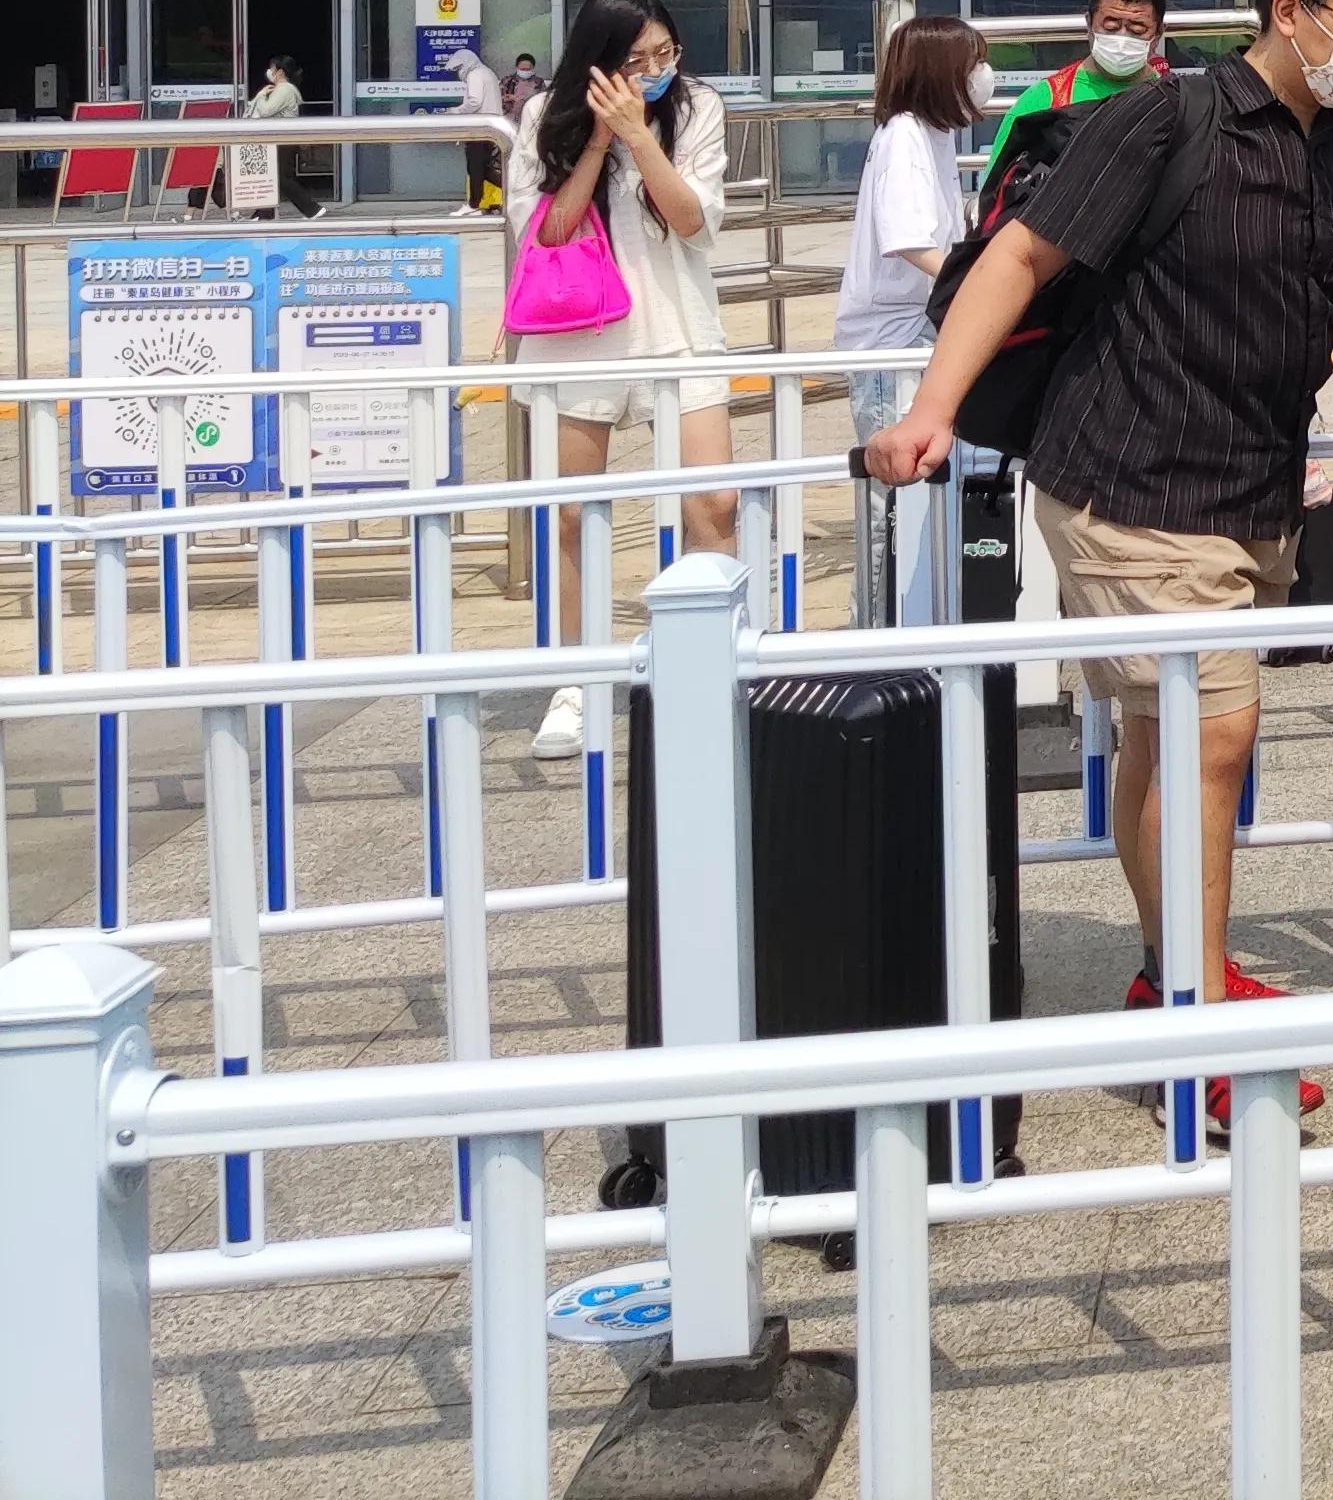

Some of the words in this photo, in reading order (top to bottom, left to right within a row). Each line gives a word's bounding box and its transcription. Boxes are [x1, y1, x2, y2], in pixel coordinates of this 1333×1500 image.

[82, 255, 251, 280] 打开微信扫一扫
